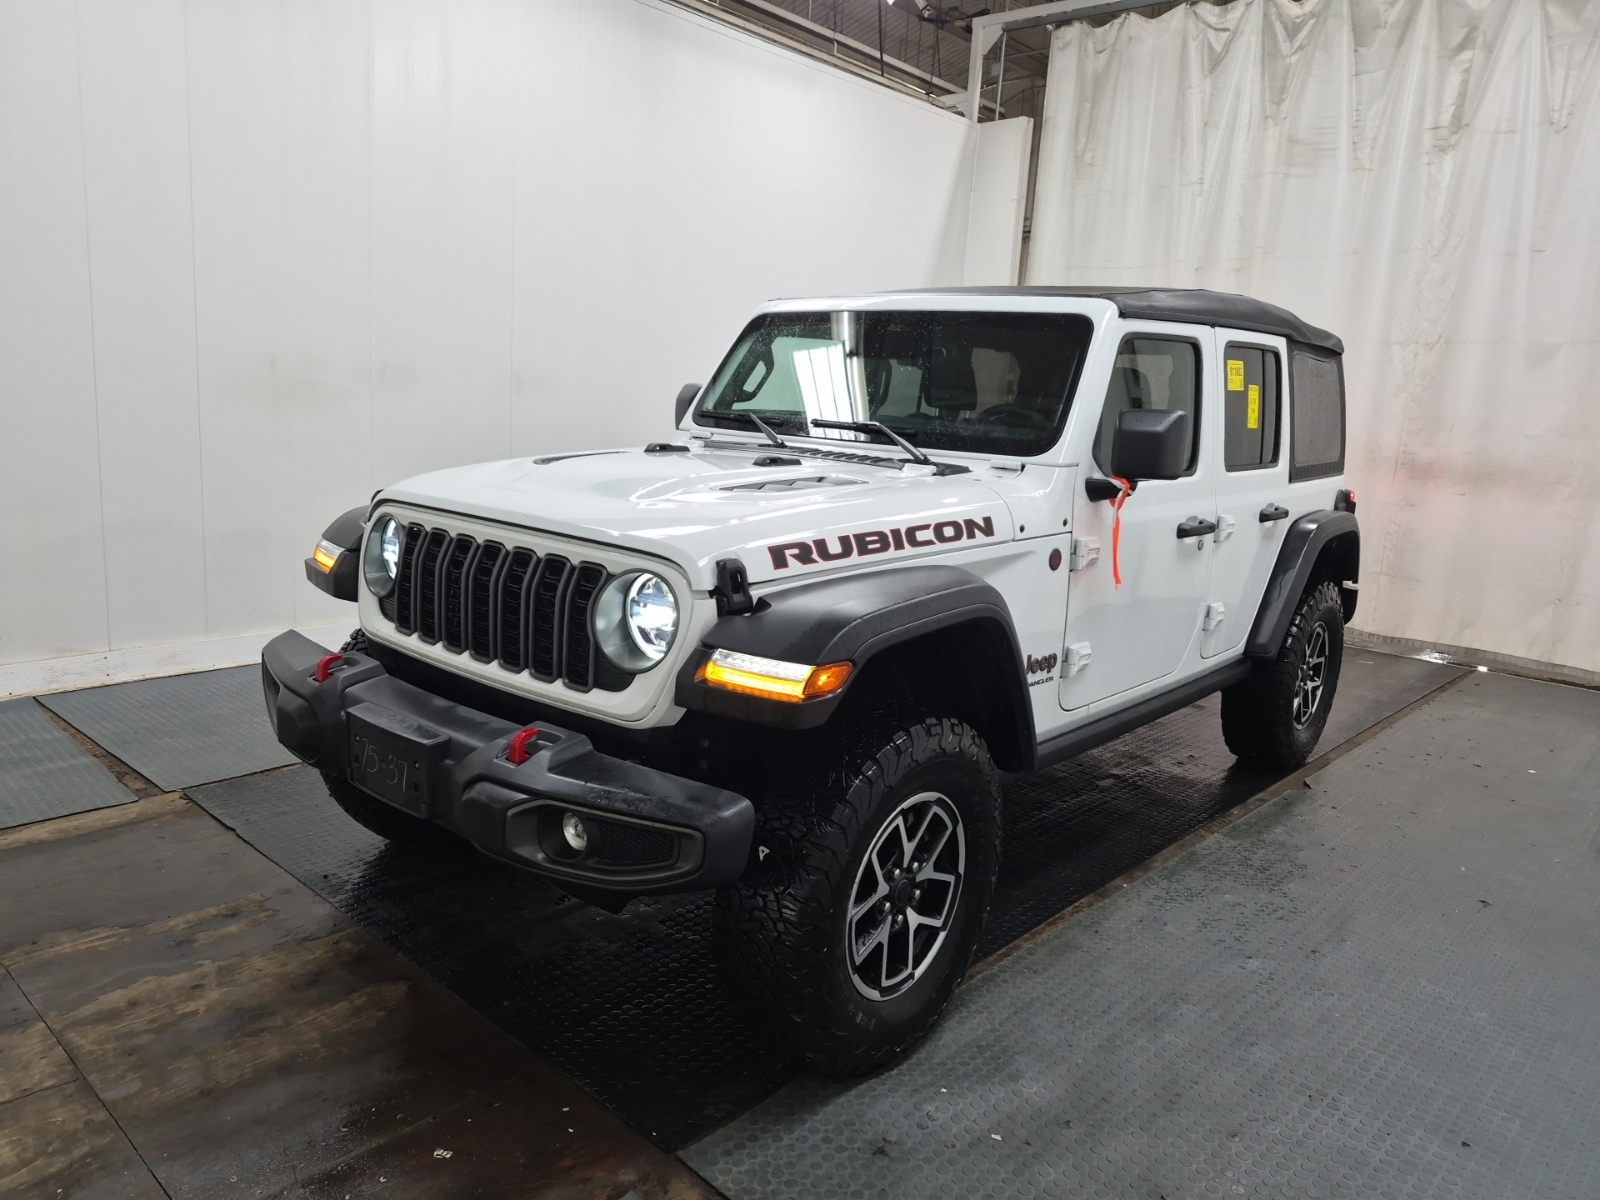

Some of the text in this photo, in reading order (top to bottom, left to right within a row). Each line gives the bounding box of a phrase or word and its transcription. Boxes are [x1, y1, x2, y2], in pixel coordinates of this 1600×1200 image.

[767, 515, 995, 570] RUBICON
[1025, 652, 1058, 675] Jeep
[1028, 676, 1054, 687] ANGLER
